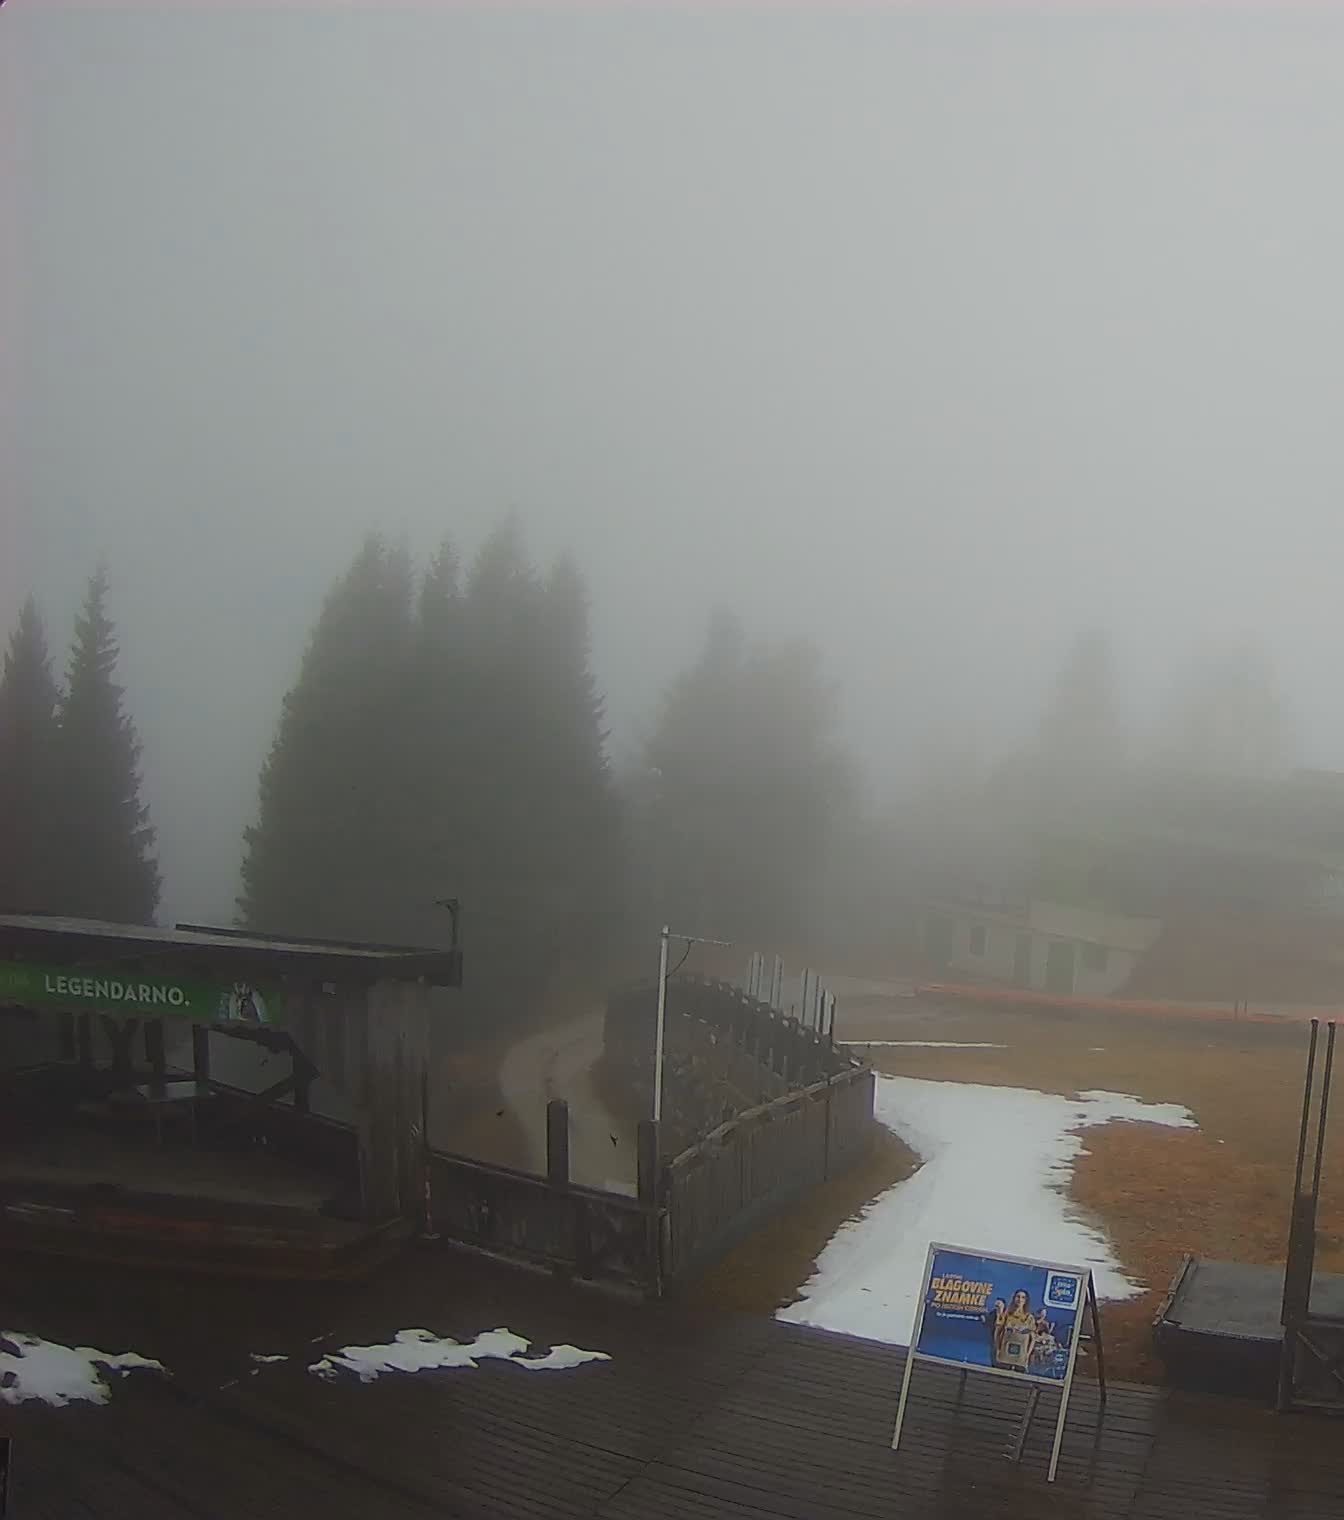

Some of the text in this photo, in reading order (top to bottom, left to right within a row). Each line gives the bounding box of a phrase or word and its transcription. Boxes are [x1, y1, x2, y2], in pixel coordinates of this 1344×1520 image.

[44, 974, 191, 1007] LEGENDARNO.
[931, 1278, 994, 1295] BLAGOVNE
[934, 1290, 987, 1306] ZNAMKE
